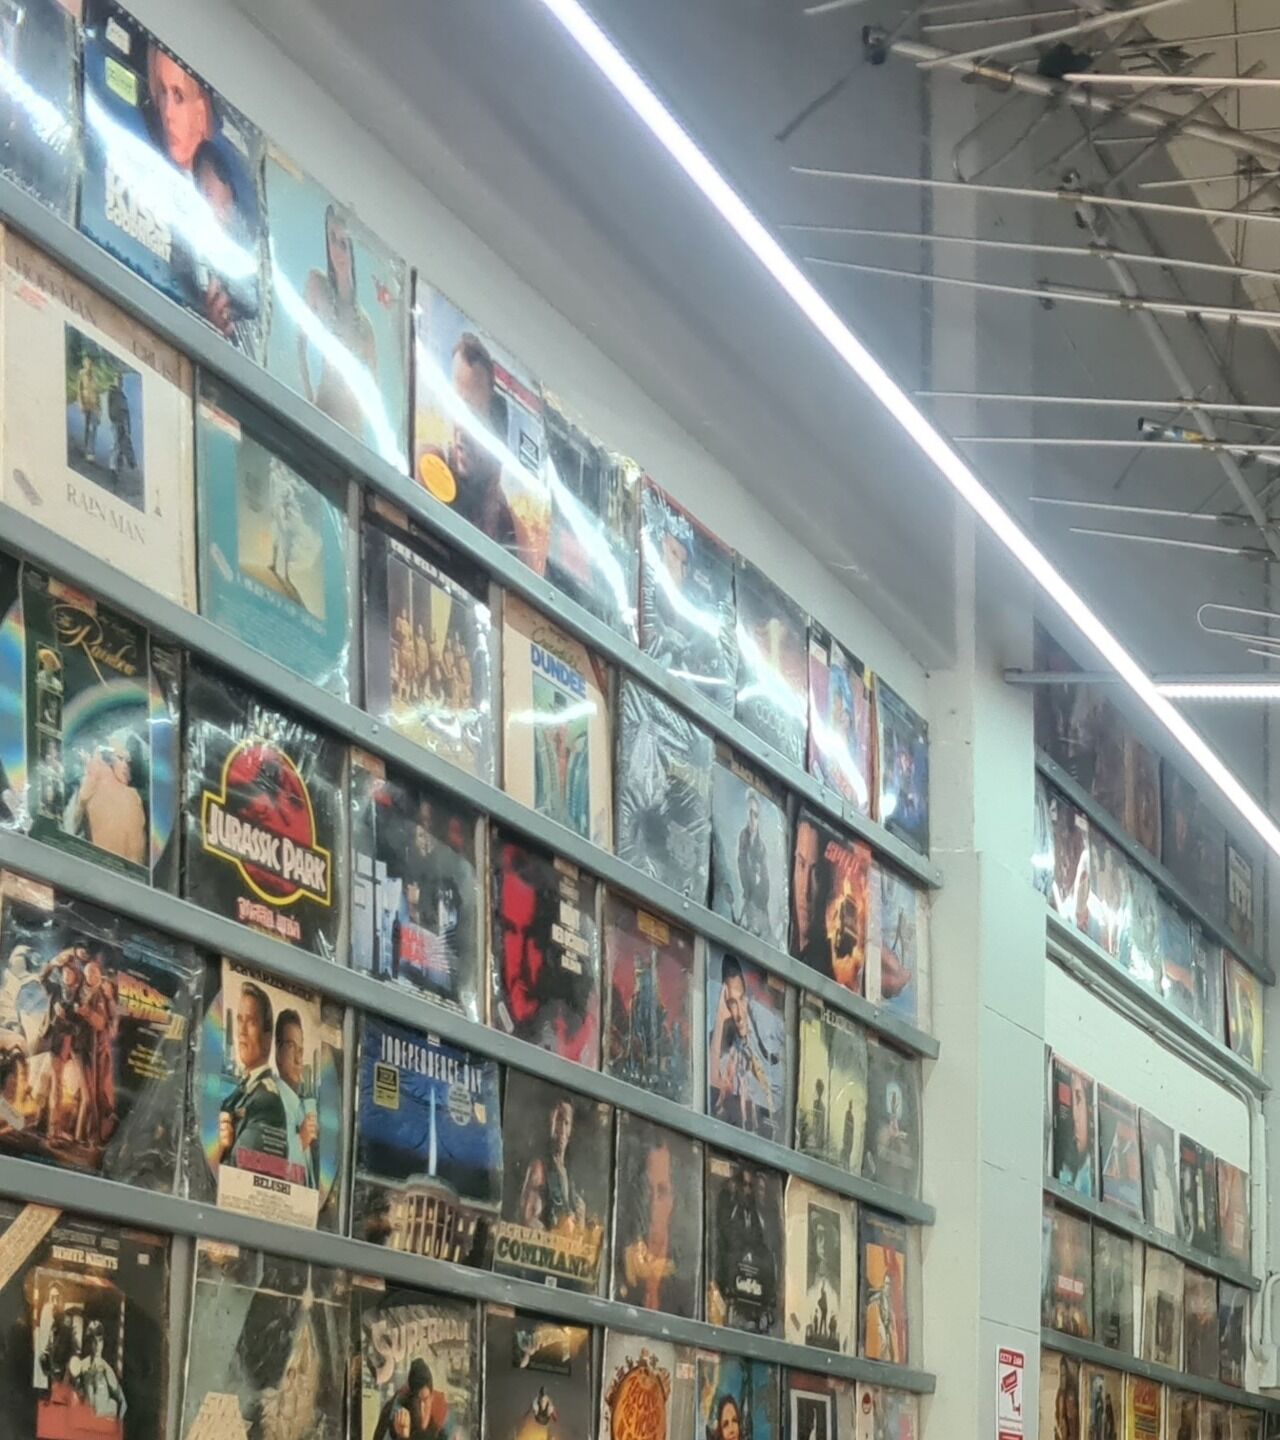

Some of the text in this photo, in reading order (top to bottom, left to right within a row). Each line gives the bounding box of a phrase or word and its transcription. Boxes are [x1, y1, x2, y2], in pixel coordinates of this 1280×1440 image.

[530, 642, 587, 700] DUNDEE
[207, 802, 327, 893] JURASSIC PARK
[381, 1032, 460, 1086] INDEPENDENCE
[252, 1174, 292, 1196] BELUSHI
